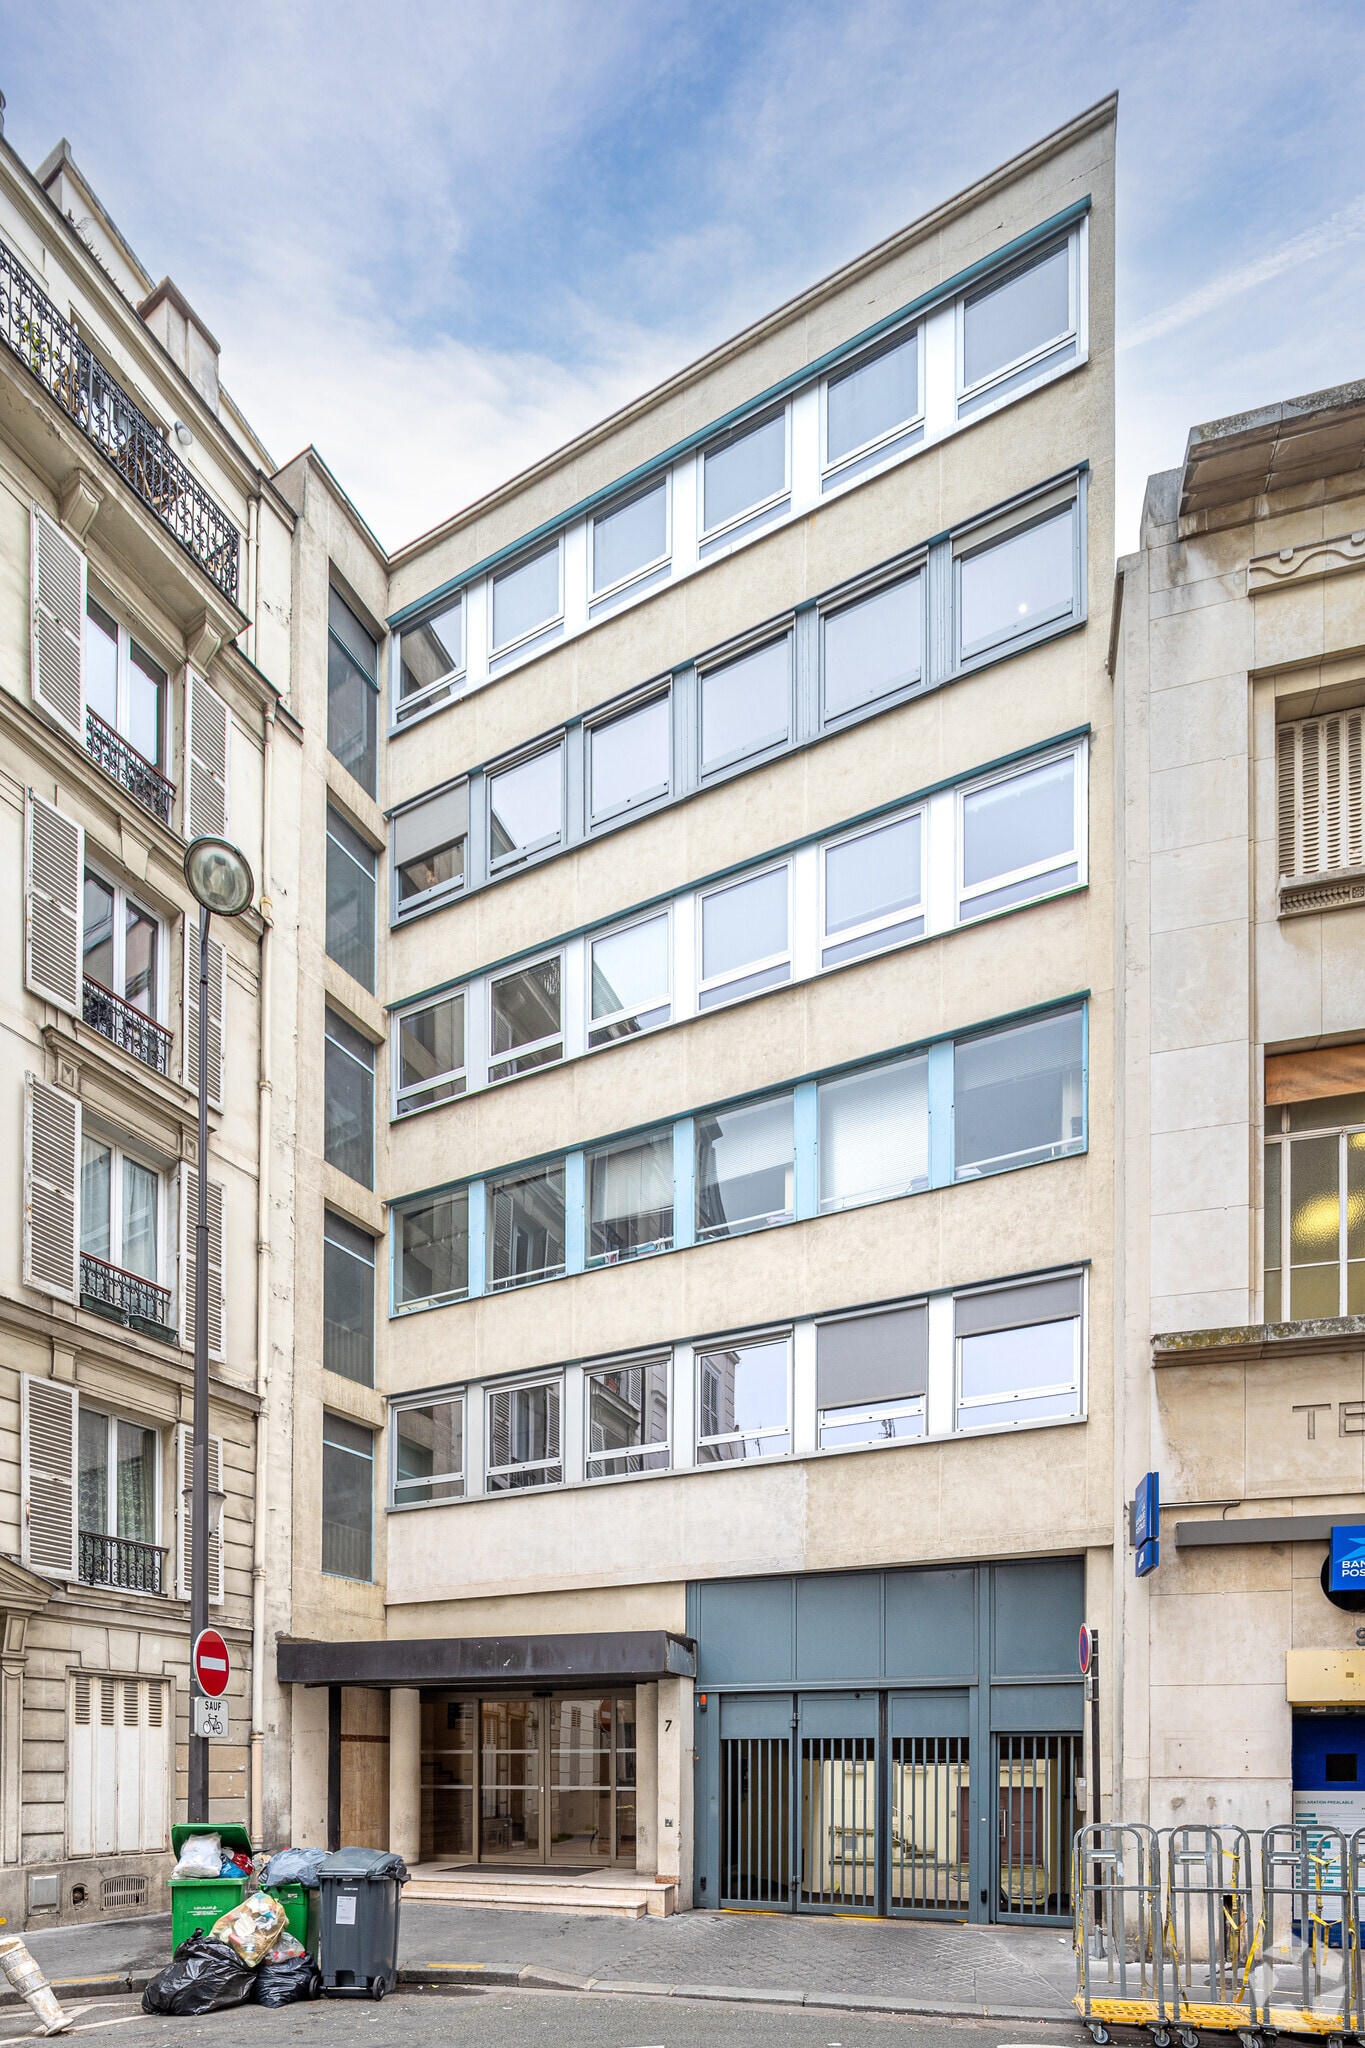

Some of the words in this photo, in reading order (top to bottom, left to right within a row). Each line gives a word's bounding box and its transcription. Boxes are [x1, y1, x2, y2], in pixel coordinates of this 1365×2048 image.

[1292, 1401, 1365, 1440] TE
[205, 1700, 221, 1711] SAUF
[665, 1719, 672, 1732] 7
